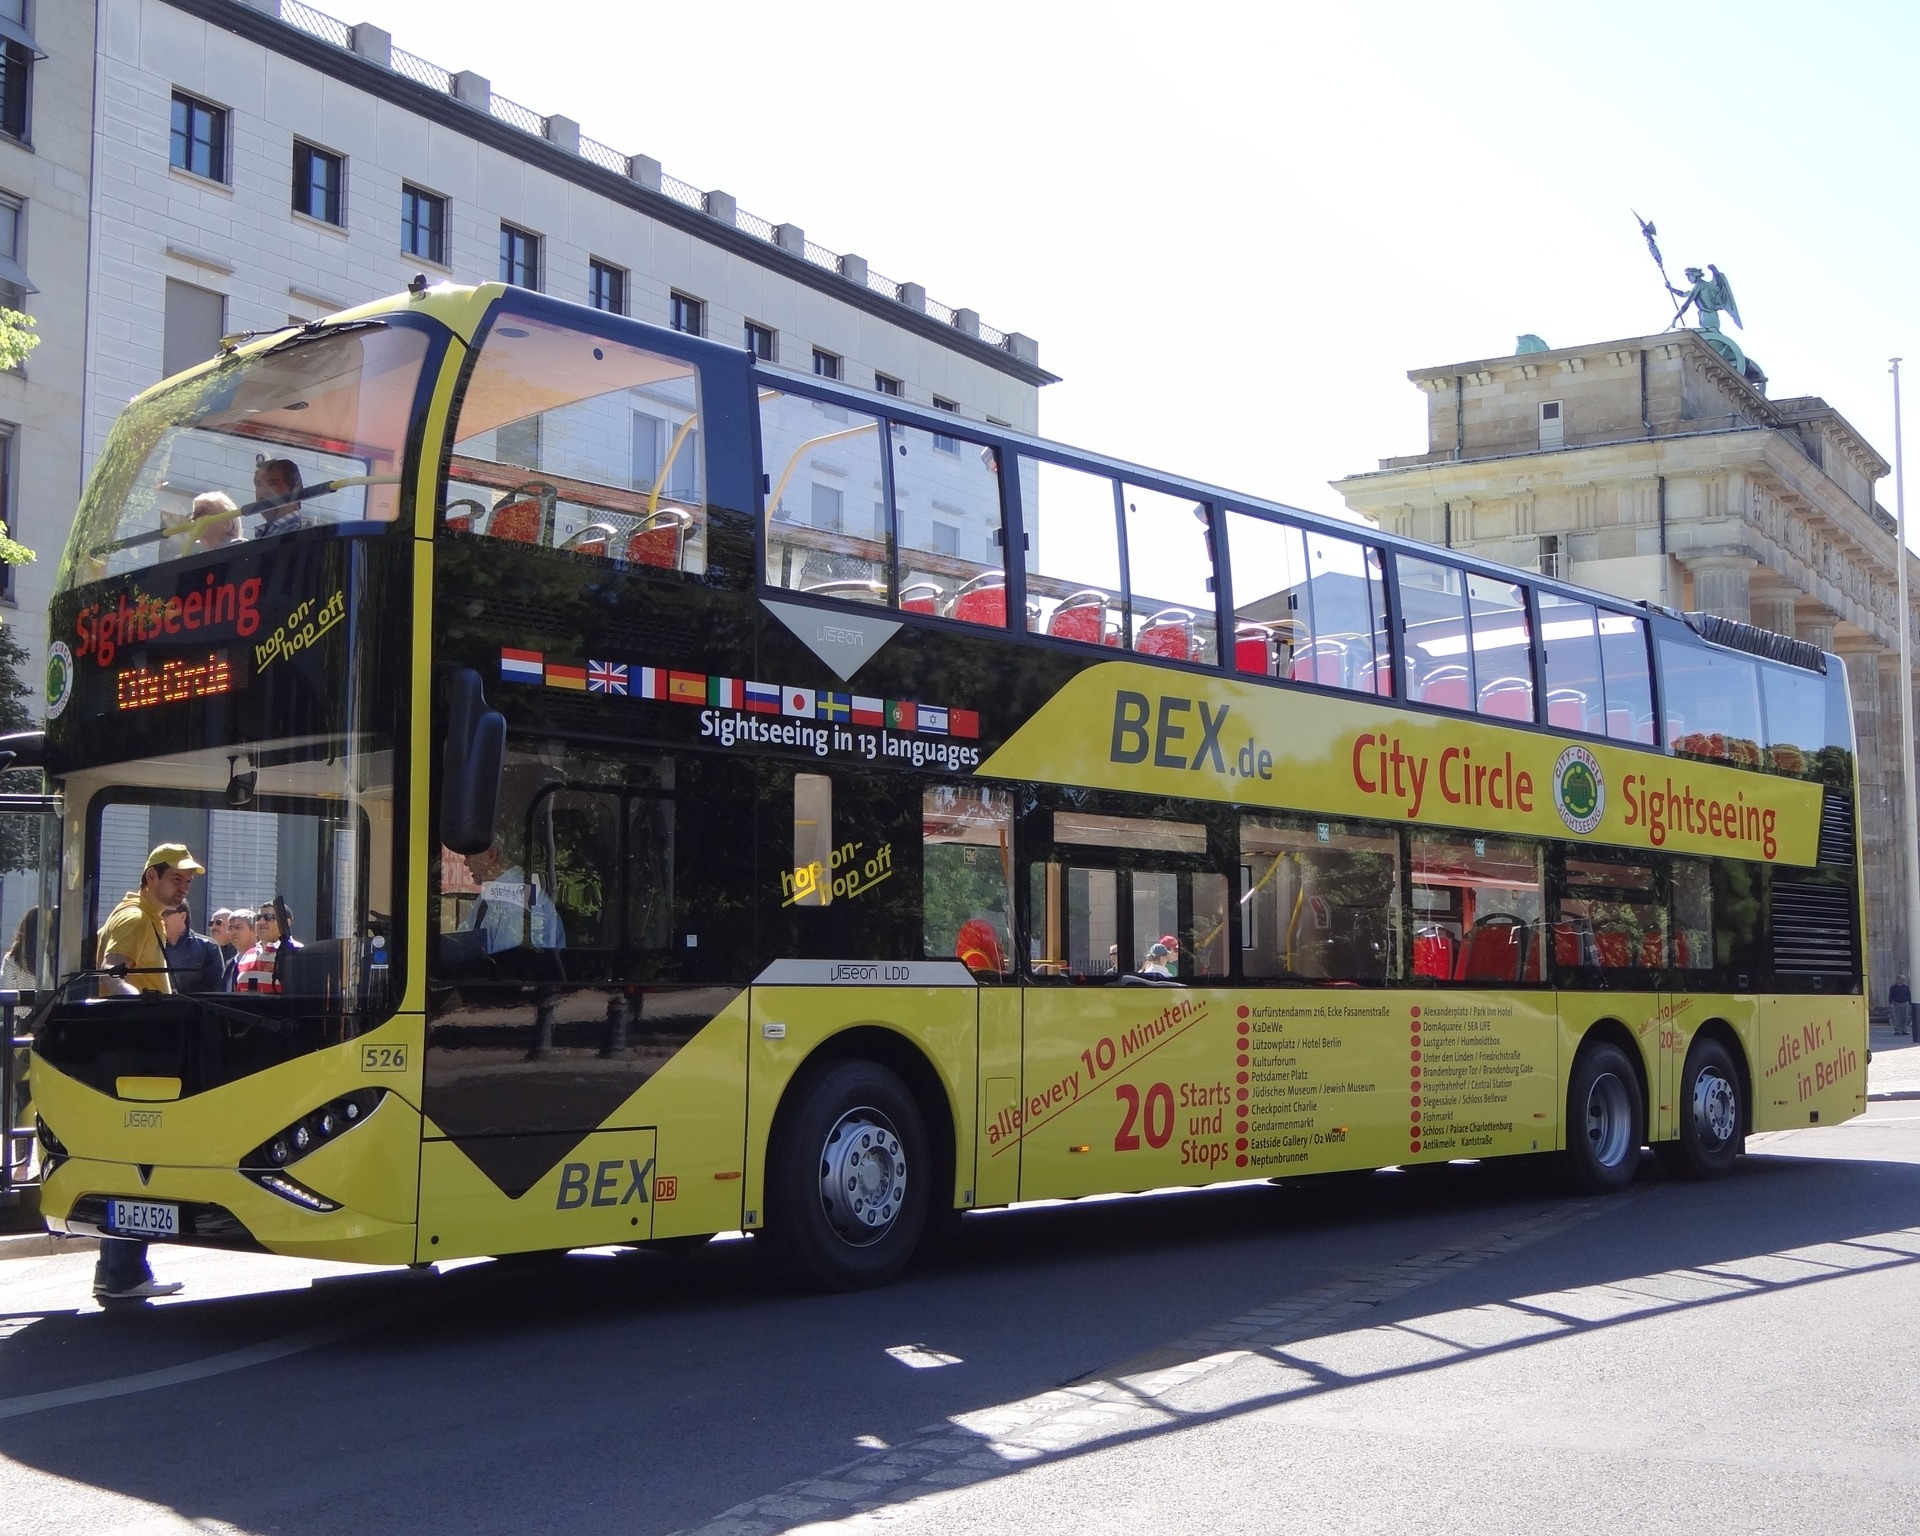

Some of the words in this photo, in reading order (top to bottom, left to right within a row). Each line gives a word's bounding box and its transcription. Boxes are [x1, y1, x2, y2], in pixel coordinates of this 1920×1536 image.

[76, 573, 262, 667] Sightseeing
[282, 623, 315, 661] hop
[318, 590, 344, 626] off
[255, 627, 285, 665] hop
[287, 598, 316, 629] on-
[118, 667, 160, 710] City
[164, 653, 229, 701] Circle
[701, 711, 828, 756] Sightseeing
[834, 727, 853, 751] in
[858, 734, 877, 759] 13
[883, 728, 979, 770] languages
[1110, 690, 1272, 780] BEX.de
[1351, 733, 1428, 818] City
[1439, 747, 1534, 812] Circle
[1559, 803, 1601, 832] SIGHTSEEING
[1623, 774, 1777, 859] Sightseeing
[781, 861, 822, 897] hop
[828, 842, 863, 869] on-
[819, 870, 859, 906] hop
[864, 843, 892, 878] off
[885, 965, 910, 982] LDD
[1252, 1006, 1312, 1018] Kurfürstendamm
[1328, 1006, 1342, 1017] Ecke
[1344, 1006, 1390, 1017] Fasanenstraße
[1424, 1006, 1468, 1019] Alexanderplatz
[1474, 1007, 1486, 1016] Park
[1487, 1007, 1496, 1016] Inn
[1498, 1007, 1512, 1016] Hotel
[1252, 1022, 1283, 1033] KaDeWe
[1468, 1022, 1478, 1030] SEA
[1480, 1021, 1490, 1030] LIFE
[1252, 1039, 1295, 1052] Lützowplatz
[1302, 1038, 1320, 1048] Hotel
[1322, 1037, 1342, 1048] Berlin
[1423, 1036, 1455, 1049] Lustgarten
[1461, 1035, 1500, 1046] Humboldtbox
[1661, 1031, 1672, 1049] 20
[1765, 1035, 1800, 1079] ...die
[1804, 1021, 1825, 1055] Nr.
[1826, 1019, 1833, 1041] 1
[366, 1048, 404, 1068] 526
[1252, 1056, 1296, 1067] Kulturforum
[1424, 1052, 1440, 1062] Unter
[1442, 1052, 1453, 1062] den
[1454, 1051, 1474, 1061] Linden
[1479, 1050, 1521, 1061] Friedrichstraße
[988, 1071, 1080, 1144] alle/every
[1081, 1038, 1116, 1080] 10
[1120, 998, 1207, 1058] Minuten...
[1252, 1070, 1290, 1082] Potsdamer
[1291, 1070, 1308, 1080] Platz
[1423, 1067, 1467, 1078] Brandenburger
[1469, 1067, 1478, 1076] Tor
[1483, 1065, 1519, 1076] Brandenburg
[1521, 1064, 1533, 1073] Gate
[1797, 1072, 1811, 1102] in
[1816, 1046, 1857, 1092] Berlin
[1252, 1086, 1286, 1098] Jüdisches
[1288, 1086, 1317, 1096] Museum
[1324, 1083, 1345, 1094] Jewish
[1348, 1082, 1375, 1092] Museum
[1423, 1080, 1466, 1094] Hauptbahnhof
[1472, 1080, 1491, 1090] Central
[1493, 1079, 1512, 1089] Station
[1252, 1102, 1292, 1116] Checkpoint
[1293, 1100, 1317, 1112] Charlie
[1423, 1096, 1457, 1108] Siegessäule
[1462, 1095, 1483, 1104] Schloss
[1484, 1093, 1507, 1103] Bellevue
[1114, 1082, 1175, 1152] 20
[1180, 1082, 1231, 1108] Starts
[1189, 1108, 1222, 1136] und
[1252, 1118, 1314, 1132] Gendarmenmarkt
[1423, 1112, 1453, 1122] Flohmarkt
[1423, 1126, 1444, 1136] Schloss
[1450, 1124, 1468, 1134] Palace
[1469, 1122, 1512, 1133] Charlottenburg
[1252, 1137, 1281, 1150] Eastside
[1283, 1134, 1308, 1148] Gallery
[1325, 1132, 1346, 1143] World
[1461, 1135, 1492, 1146] Kantstraße
[1181, 1139, 1229, 1170] Stops
[1251, 1152, 1308, 1168] Neptunbrunnen
[556, 1156, 655, 1210] BEX
[657, 1177, 676, 1200] DB
[118, 1204, 126, 1225] B
[133, 1206, 148, 1228] EX
[151, 1207, 173, 1230] 526
